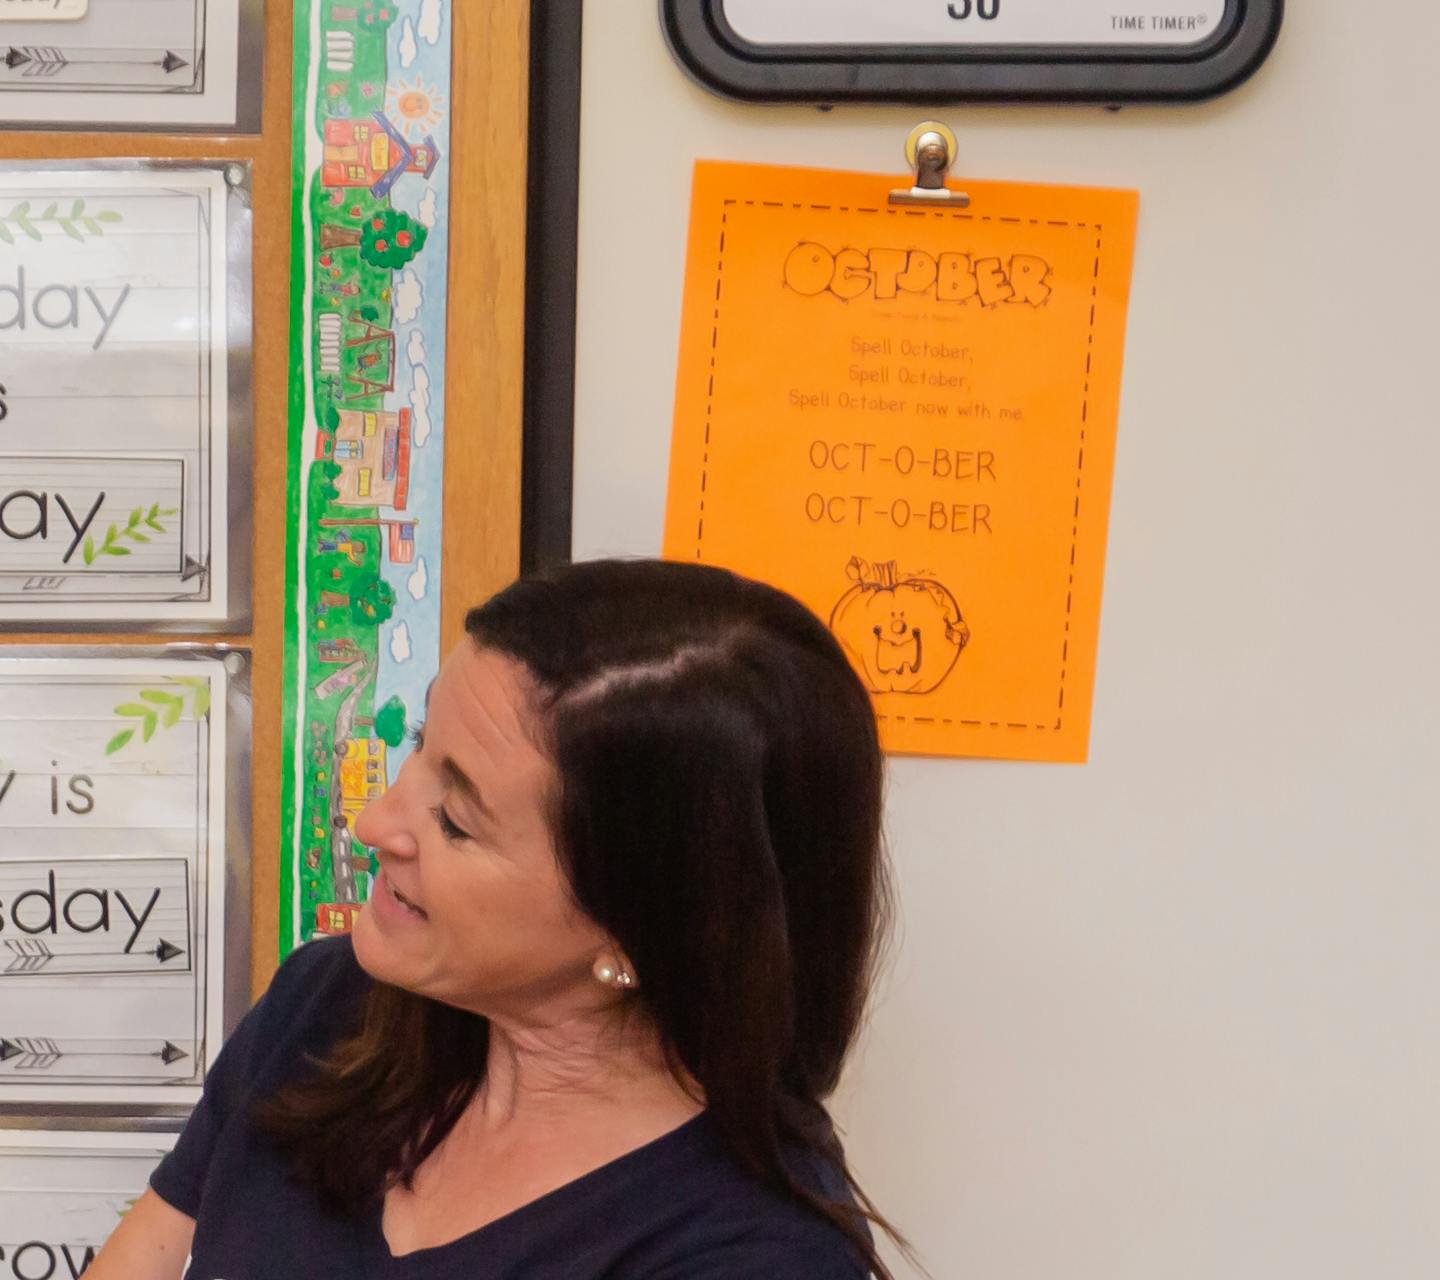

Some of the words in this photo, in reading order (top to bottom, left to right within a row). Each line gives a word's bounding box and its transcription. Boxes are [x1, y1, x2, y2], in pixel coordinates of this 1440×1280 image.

[1111, 15, 1144, 30] TIME
[782, 241, 1052, 309] OCTOBER
[850, 336, 892, 355] Spell
[848, 364, 889, 386] Spell
[788, 390, 830, 410] Spell
[838, 392, 906, 414] October
[958, 403, 991, 418] with
[809, 440, 997, 481] OCT-O-BER
[805, 493, 992, 533] OCT-O-BER
[50, 761, 95, 815] is
